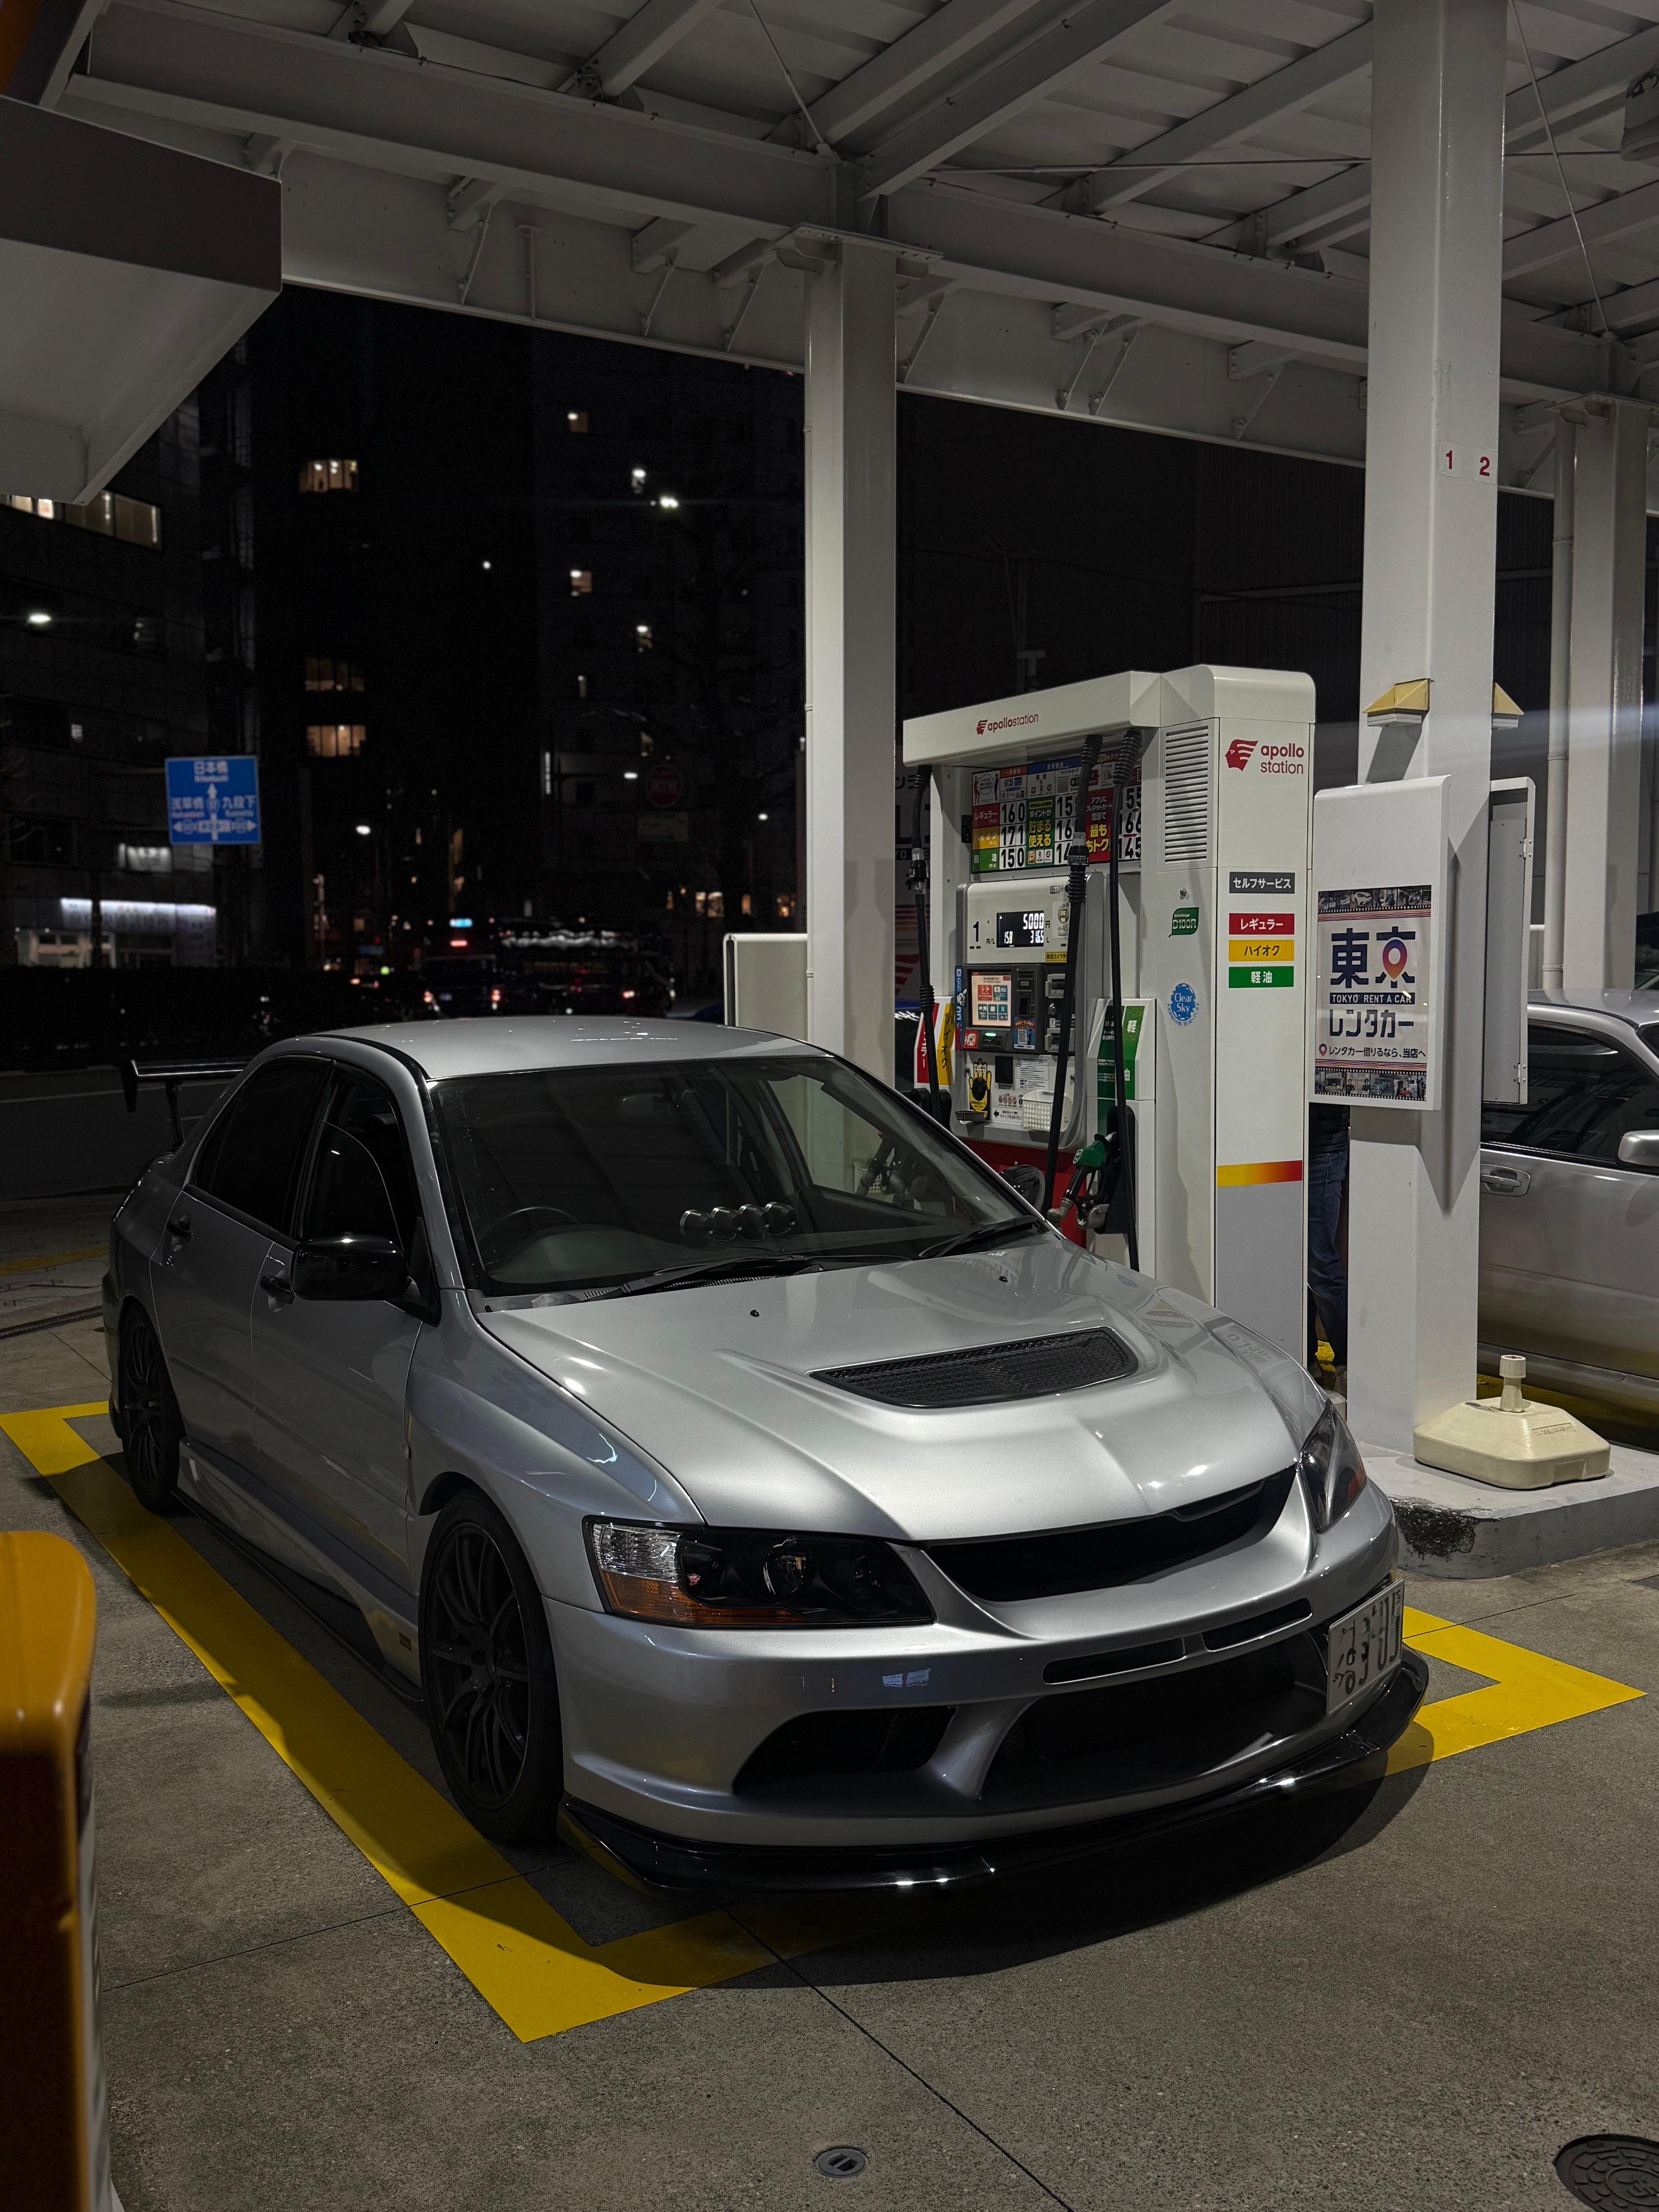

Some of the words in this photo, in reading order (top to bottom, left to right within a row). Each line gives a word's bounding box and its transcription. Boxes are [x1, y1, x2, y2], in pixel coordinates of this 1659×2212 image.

[1446, 450, 1453, 470] 1
[1479, 456, 1490, 477] 2
[988, 714, 1039, 733] apollostation
[1261, 743, 1304, 760] apollo
[1261, 761, 1303, 774] station
[1002, 802, 1025, 823] 160
[1001, 824, 1024, 846] 171
[1090, 824, 1108, 838] 最も
[1001, 847, 1024, 868] 150
[1233, 878, 1291, 889] セルフサービス
[1023, 913, 1044, 930] 5000
[1240, 918, 1283, 930] レギュラー
[973, 921, 979, 942] 1
[1244, 945, 1280, 956] ハイオク
[1330, 926, 1416, 989] 東京
[1251, 971, 1273, 984] 軽油
[1175, 993, 1192, 1002] Clear
[1332, 994, 1358, 1003] TOKYO
[1364, 994, 1384, 1003] RENT
[1386, 994, 1392, 1003] A
[1395, 994, 1412, 1003] CAR
[1177, 1003, 1190, 1014] Sky
[1329, 1009, 1414, 1038] レンタカー
[941, 1015, 953, 1069] ハイオク
[1329, 1046, 1426, 1058] レンタカー借りるなら、当店へ
